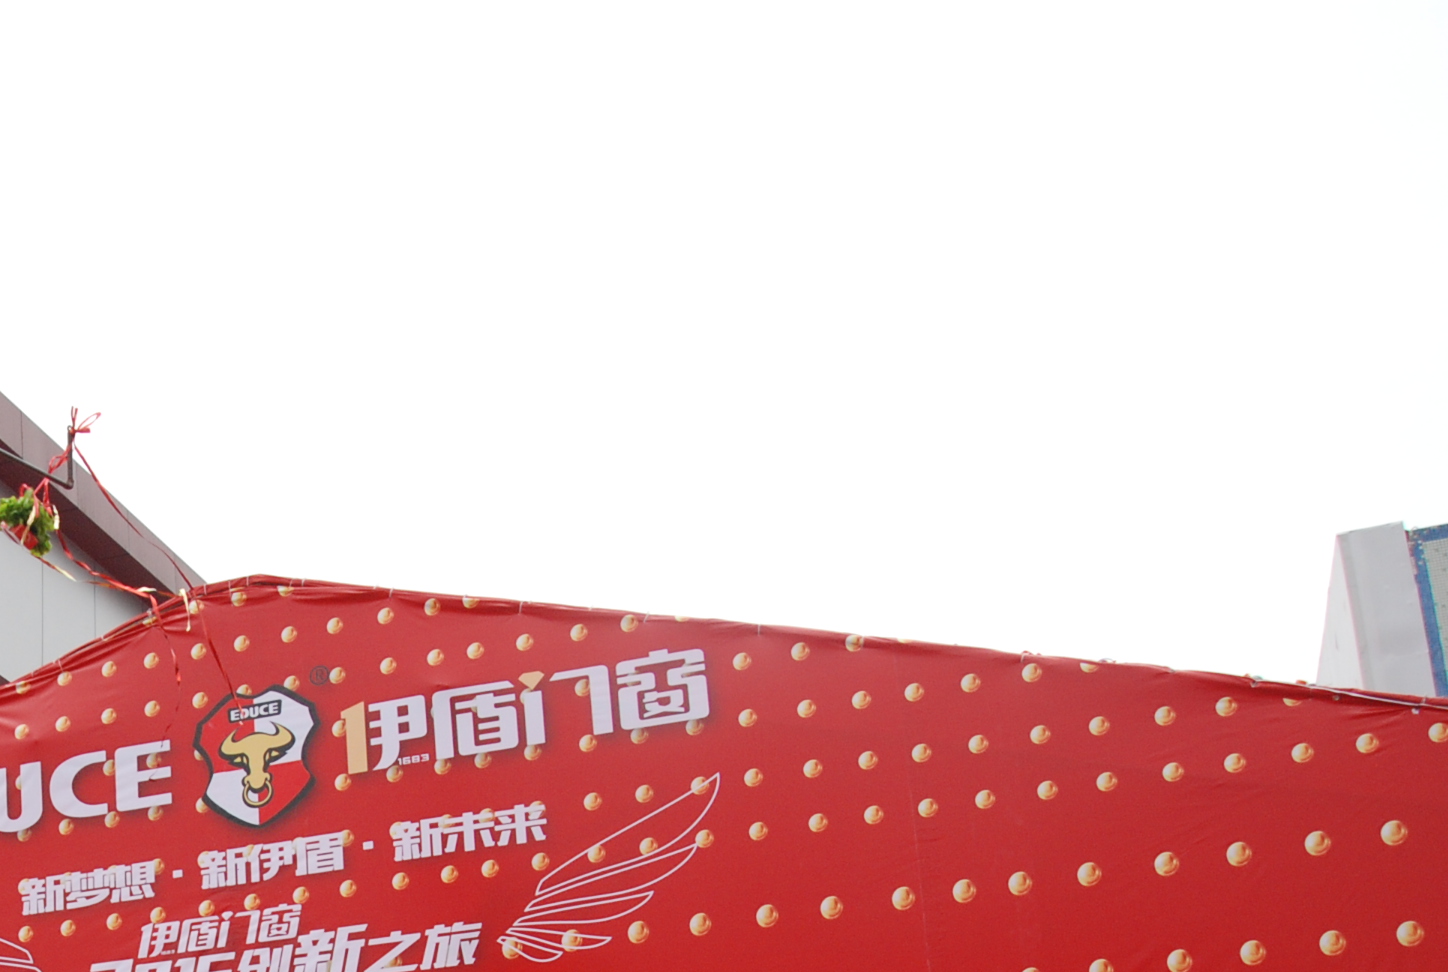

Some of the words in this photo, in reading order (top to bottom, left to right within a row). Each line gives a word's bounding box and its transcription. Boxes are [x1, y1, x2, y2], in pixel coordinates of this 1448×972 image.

[230, 702, 279, 721] EDUCE
[340, 648, 710, 775] 伊盾门窗
[397, 753, 430, 765] 1683
[138, 903, 302, 959] 伊盾门窗
